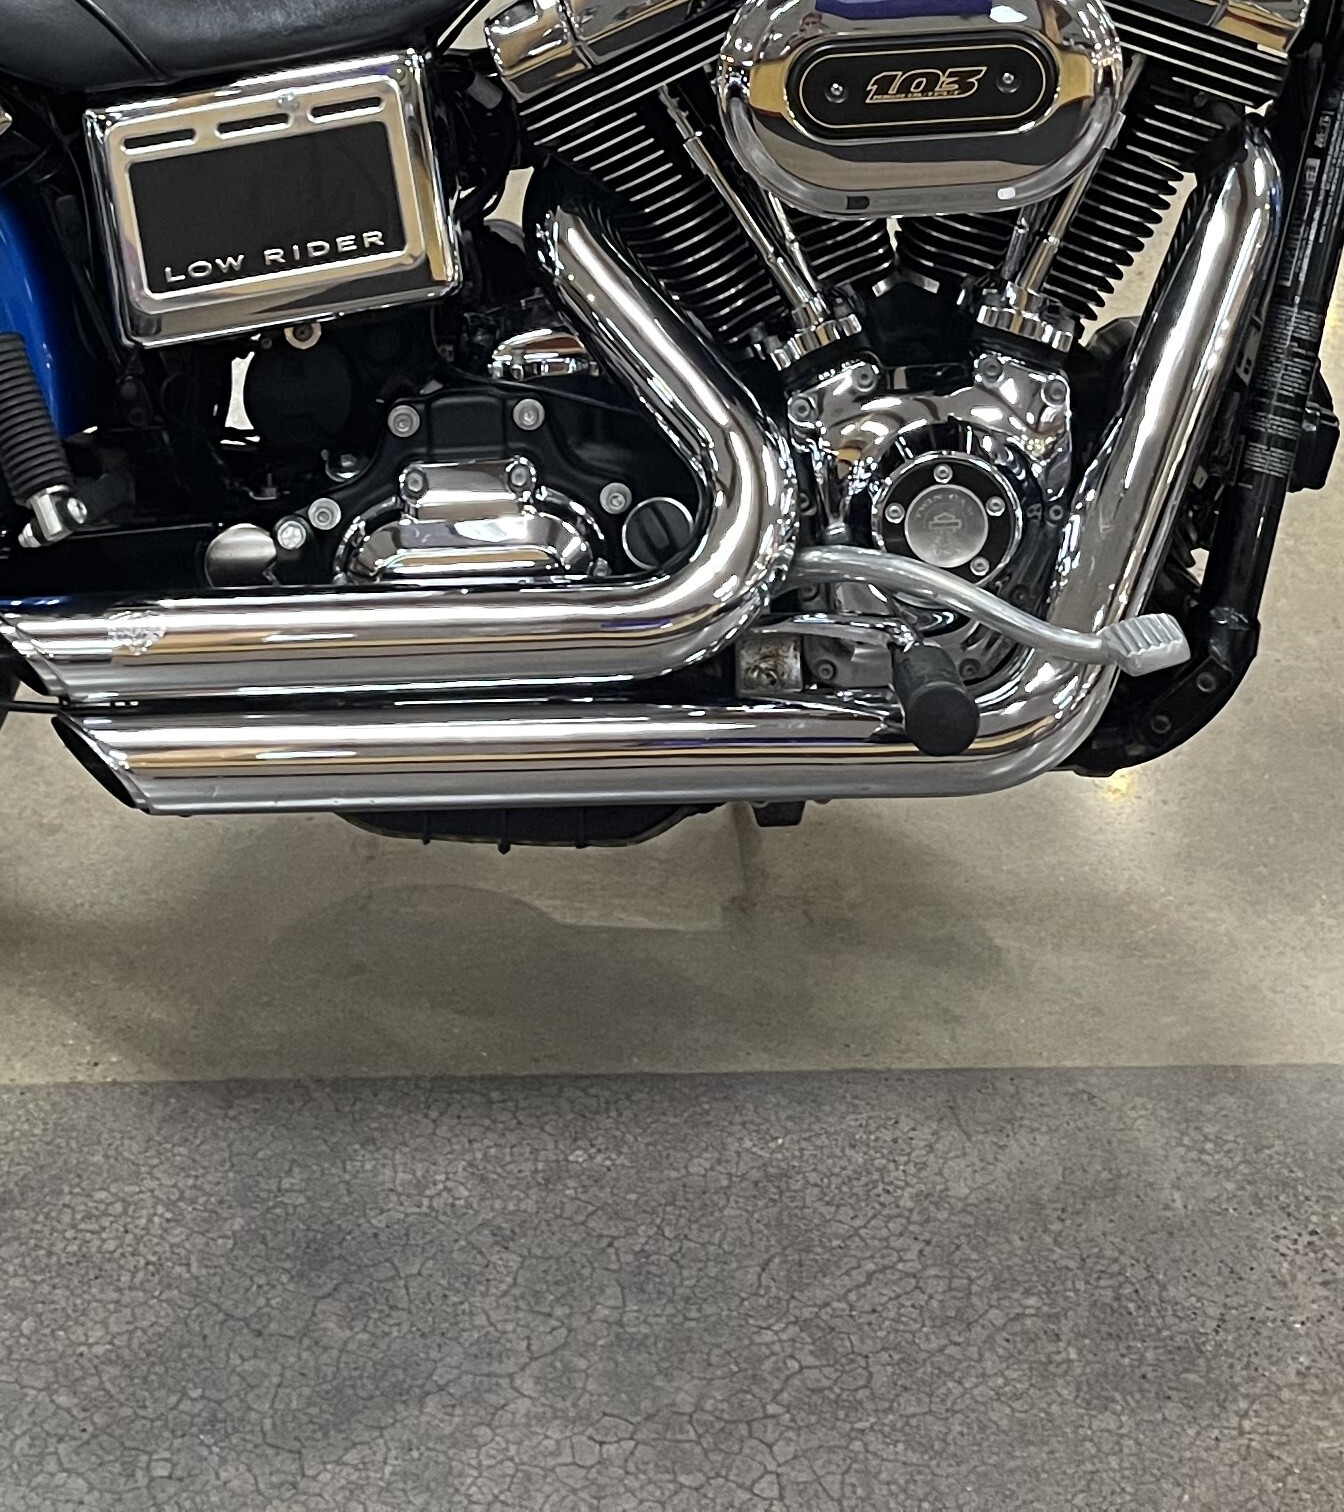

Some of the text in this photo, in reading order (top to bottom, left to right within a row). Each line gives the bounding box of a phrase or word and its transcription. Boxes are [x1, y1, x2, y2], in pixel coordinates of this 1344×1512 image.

[865, 66, 988, 104] 103
[163, 229, 386, 284] LOW RIDER
